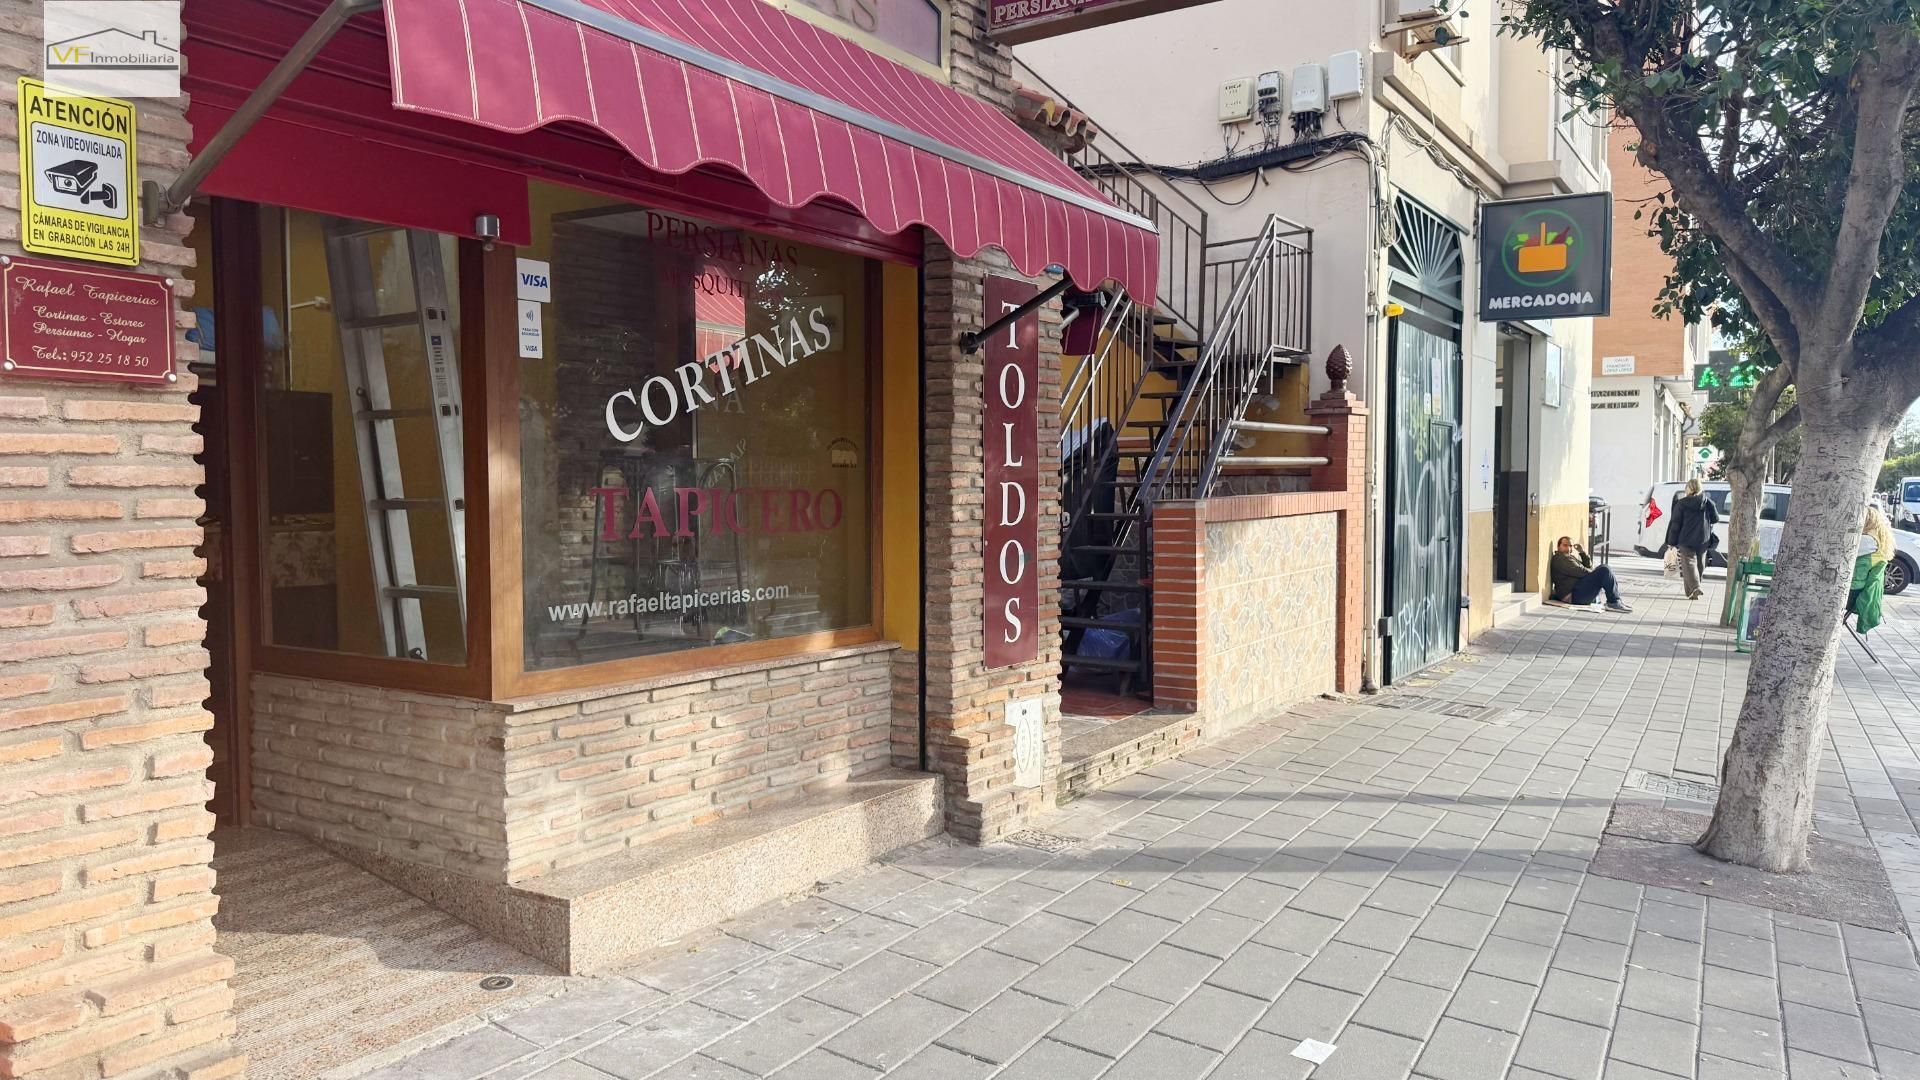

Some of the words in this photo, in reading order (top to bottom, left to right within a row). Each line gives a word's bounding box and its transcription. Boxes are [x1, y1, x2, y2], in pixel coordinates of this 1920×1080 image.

[29, 95, 128, 135] ATENCIÓN
[36, 129, 60, 148] ZONA
[61, 134, 123, 160] VIDEOVIGILADA
[32, 211, 73, 230] CÁMARAS
[74, 220, 85, 232] DE
[86, 222, 130, 239] VIGILANCIA
[33, 228, 45, 240] EN
[47, 231, 96, 248] GRABACIÓN
[98, 239, 114, 251] LAS
[116, 241, 130, 253] 24H
[646, 210, 799, 271] PERSIANAS
[15, 276, 75, 298] Rafael
[82, 284, 159, 306] Tapicerias
[520, 272, 548, 289] VISA
[1488, 291, 1594, 310] MERCADONA
[32, 305, 88, 322] Cortinas
[99, 312, 145, 329] Estores
[32, 321, 95, 339] Persianas
[106, 328, 147, 348] Hogar
[70, 350, 94, 363] 952
[97, 352, 113, 365] 25
[117, 354, 131, 366] 18
[134, 356, 150, 367] 50
[605, 305, 832, 443] CORTINAS
[999, 299, 1027, 644] TOLDOS
[588, 486, 843, 541] TAPICERO
[547, 583, 790, 622] www.rafaeltapicerias.com
